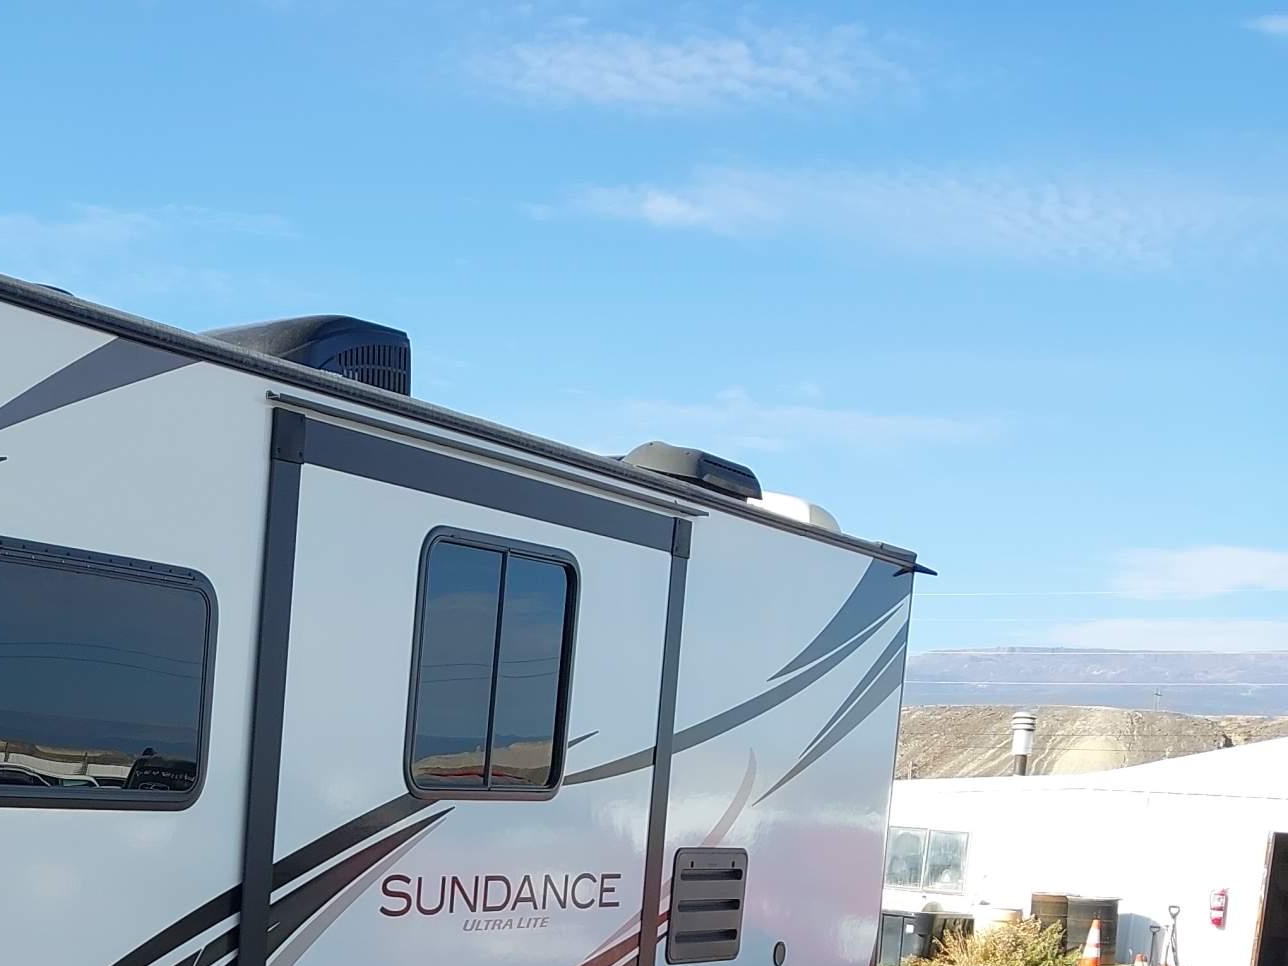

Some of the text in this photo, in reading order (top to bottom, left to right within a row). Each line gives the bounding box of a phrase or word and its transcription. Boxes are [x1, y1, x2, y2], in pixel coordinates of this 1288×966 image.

[378, 872, 623, 918] SUNDANCE
[462, 916, 551, 932] ULTRA LITE
